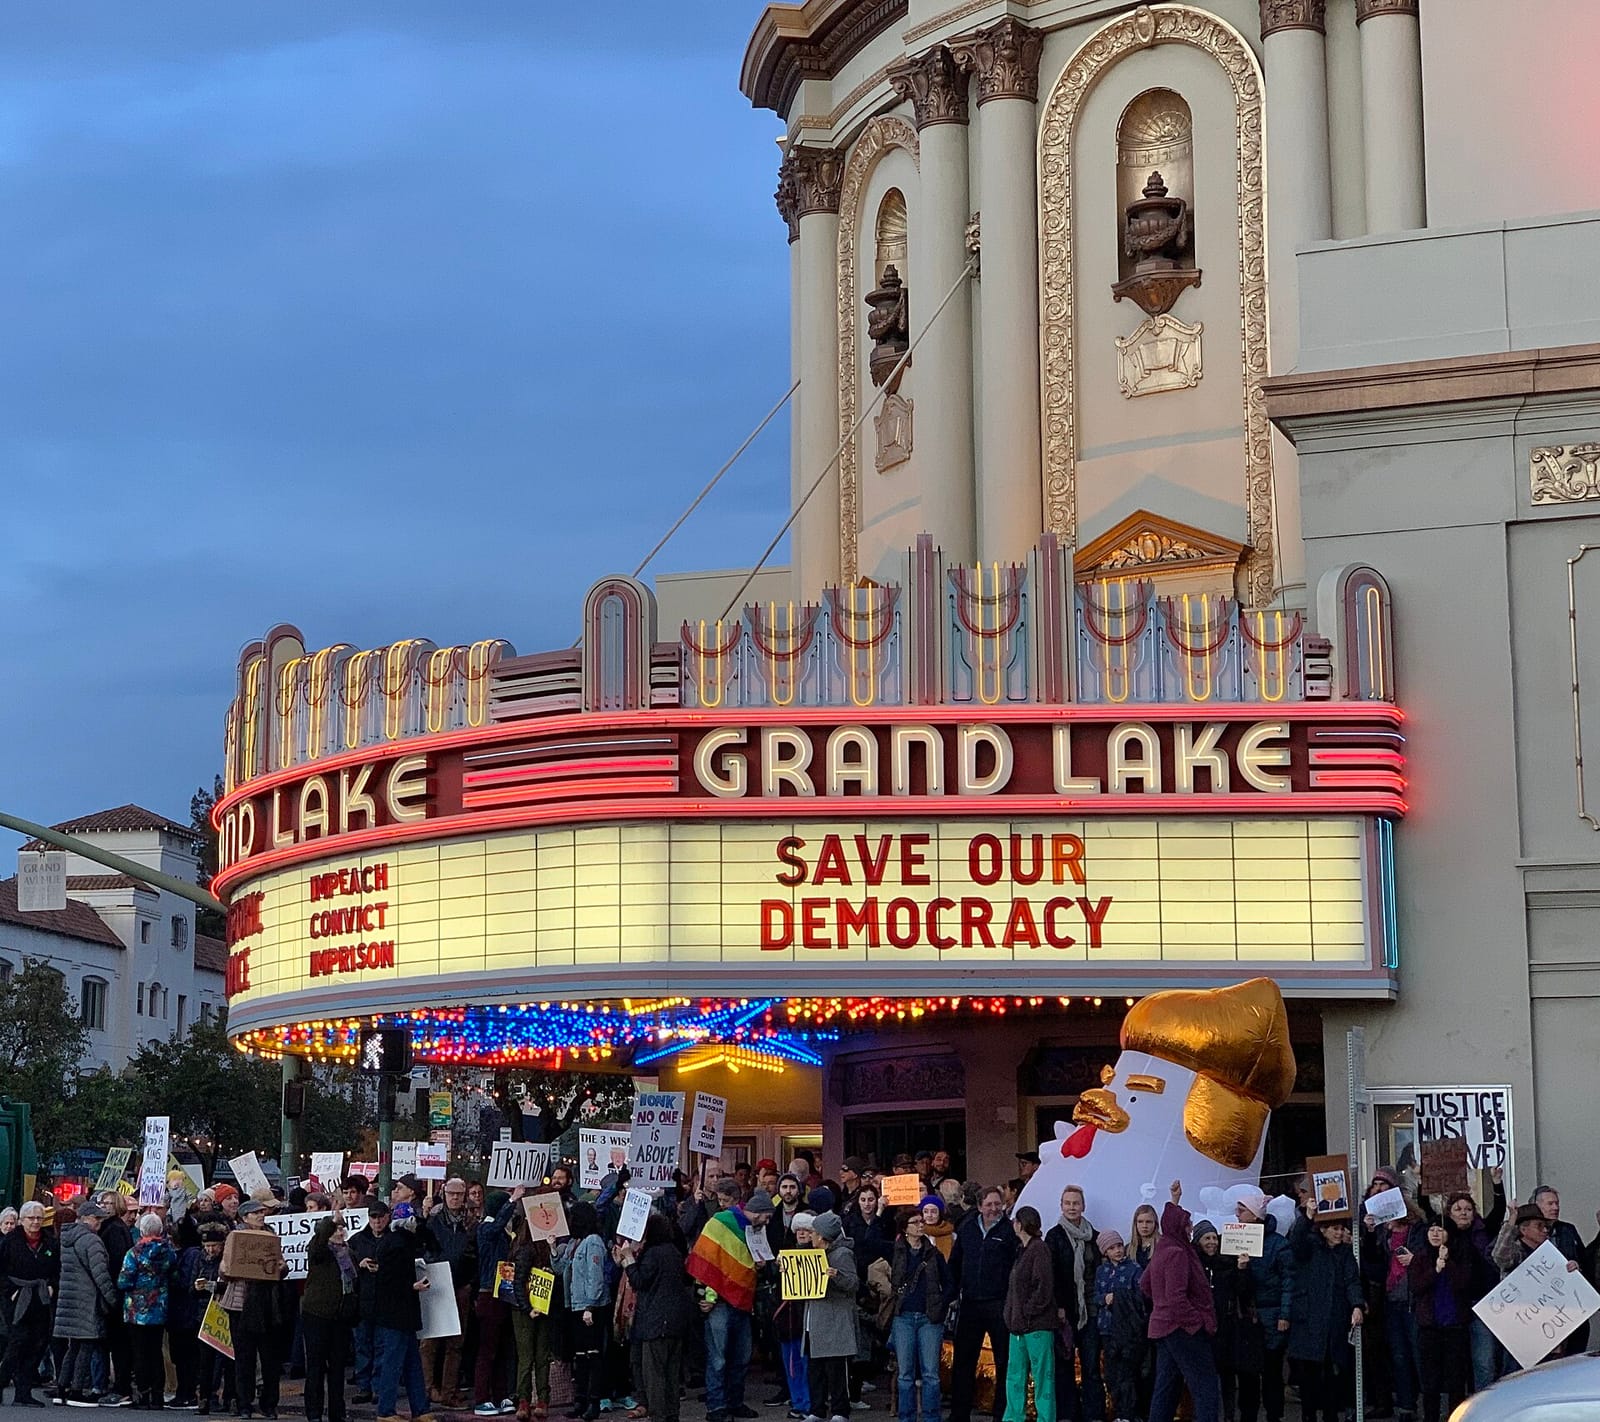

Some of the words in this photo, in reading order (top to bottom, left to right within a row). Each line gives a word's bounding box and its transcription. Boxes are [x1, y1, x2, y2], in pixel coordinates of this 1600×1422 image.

[693, 722, 1014, 798] GRAND
[1052, 719, 1293, 795] LAKE
[272, 754, 428, 849] LAKE
[24, 863, 61, 873] GRAND
[775, 833, 931, 888] SAVE
[967, 833, 1087, 887] OUR
[310, 863, 389, 903] IMPEACH
[310, 901, 389, 939] CONVICT
[760, 895, 1113, 951] DEMOCRACY
[309, 940, 395, 978] IMPRISON
[640, 1094, 676, 1109] HONK
[698, 1094, 711, 1103] SAVE
[1415, 1092, 1505, 1117] JUSTICE
[637, 1110, 655, 1123] NO
[659, 1110, 679, 1124] ONE
[1418, 1117, 1469, 1144] MUST
[1481, 1115, 1507, 1144] BE
[581, 1134, 597, 1144] THE
[600, 1135, 606, 1144] 3
[494, 1147, 546, 1181] TRAITOR
[636, 1144, 675, 1164] ABOVE
[1465, 1143, 1506, 1170] VED
[631, 1166, 644, 1177] THE
[649, 1165, 674, 1182] LAW
[782, 1254, 826, 1297] REMOVE
[203, 1323, 232, 1347] PLAN
